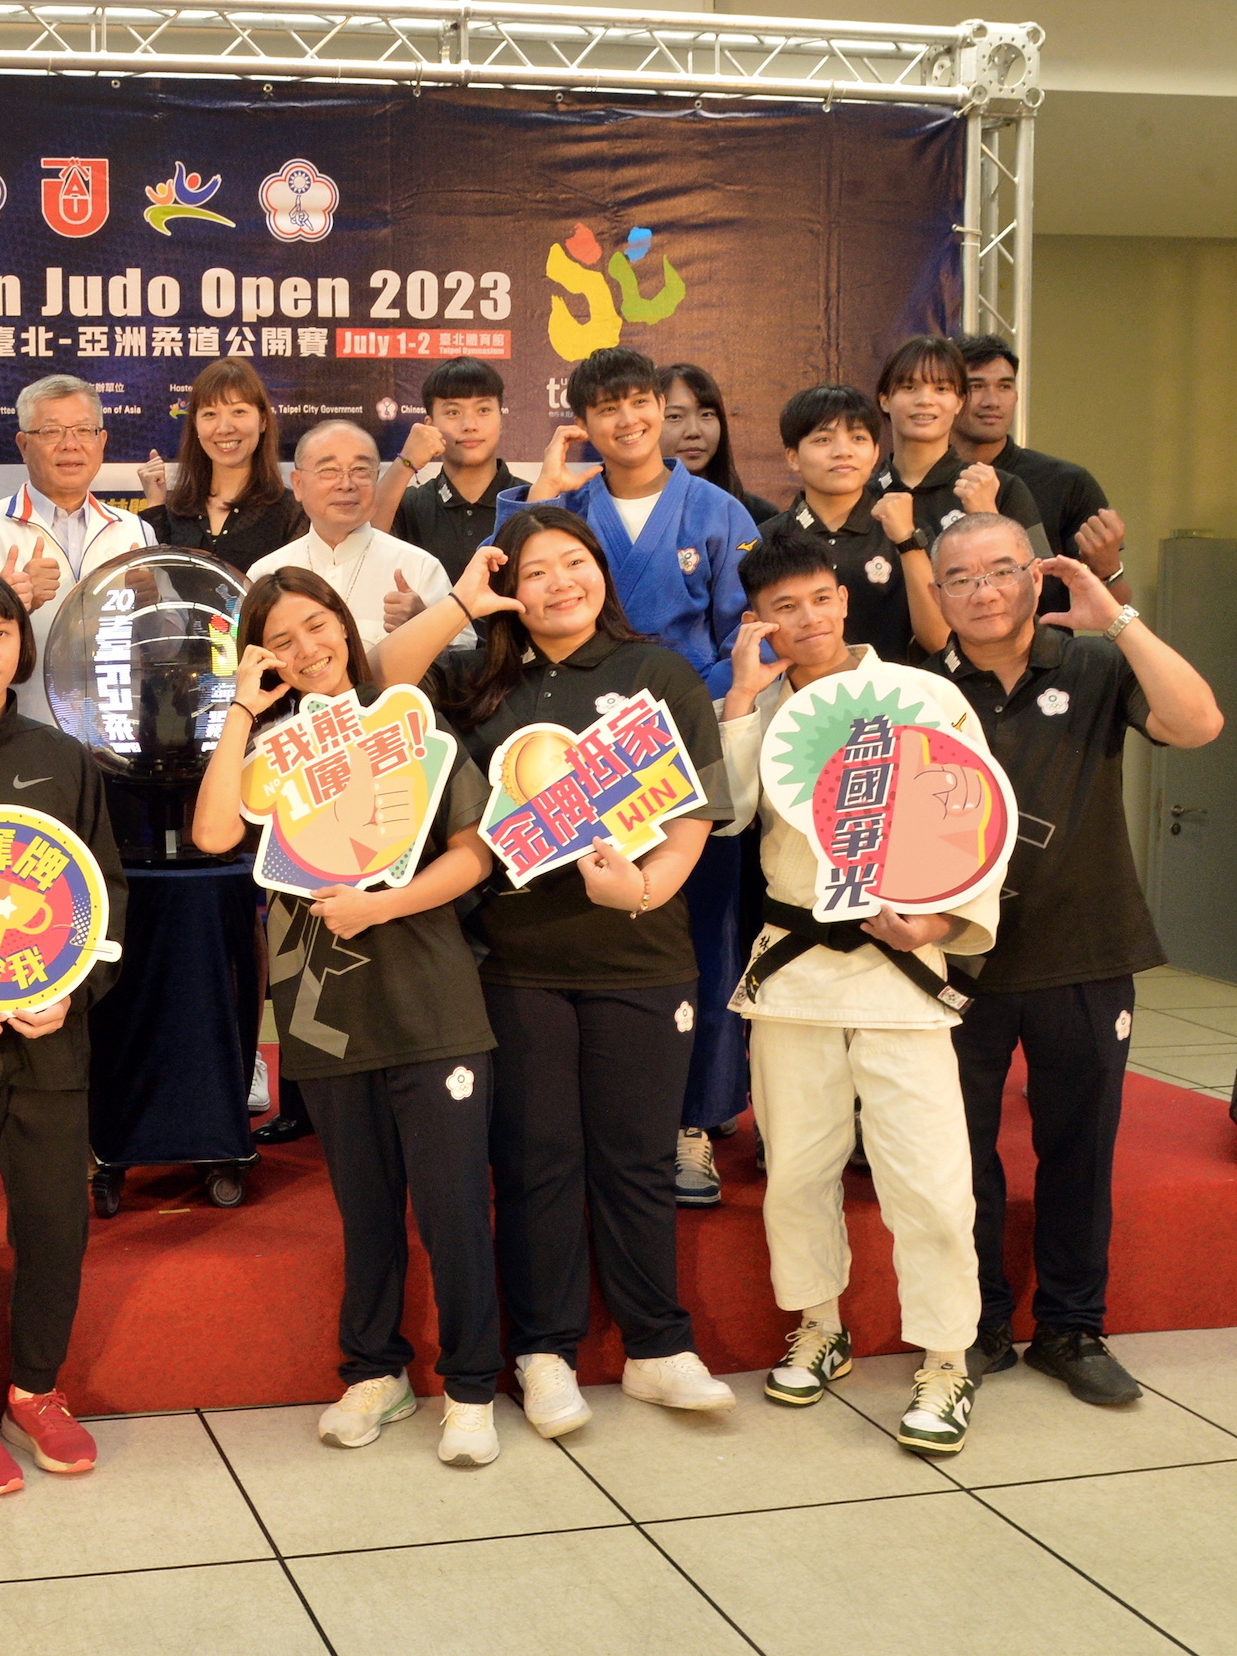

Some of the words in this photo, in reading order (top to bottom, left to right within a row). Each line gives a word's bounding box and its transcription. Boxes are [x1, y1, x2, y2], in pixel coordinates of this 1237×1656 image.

[41, 267, 181, 318] Judo
[201, 267, 350, 322] Open
[369, 269, 512, 321] 2023
[342, 331, 390, 357] July
[396, 331, 431, 355] 1-2
[113, 404, 123, 414] of
[124, 404, 142, 414] Asia
[278, 404, 302, 415] Taipei
[303, 404, 319, 415] City
[320, 404, 363, 414] Government
[616, 778, 678, 832] WIN
[823, 714, 896, 912] 為國爭光
